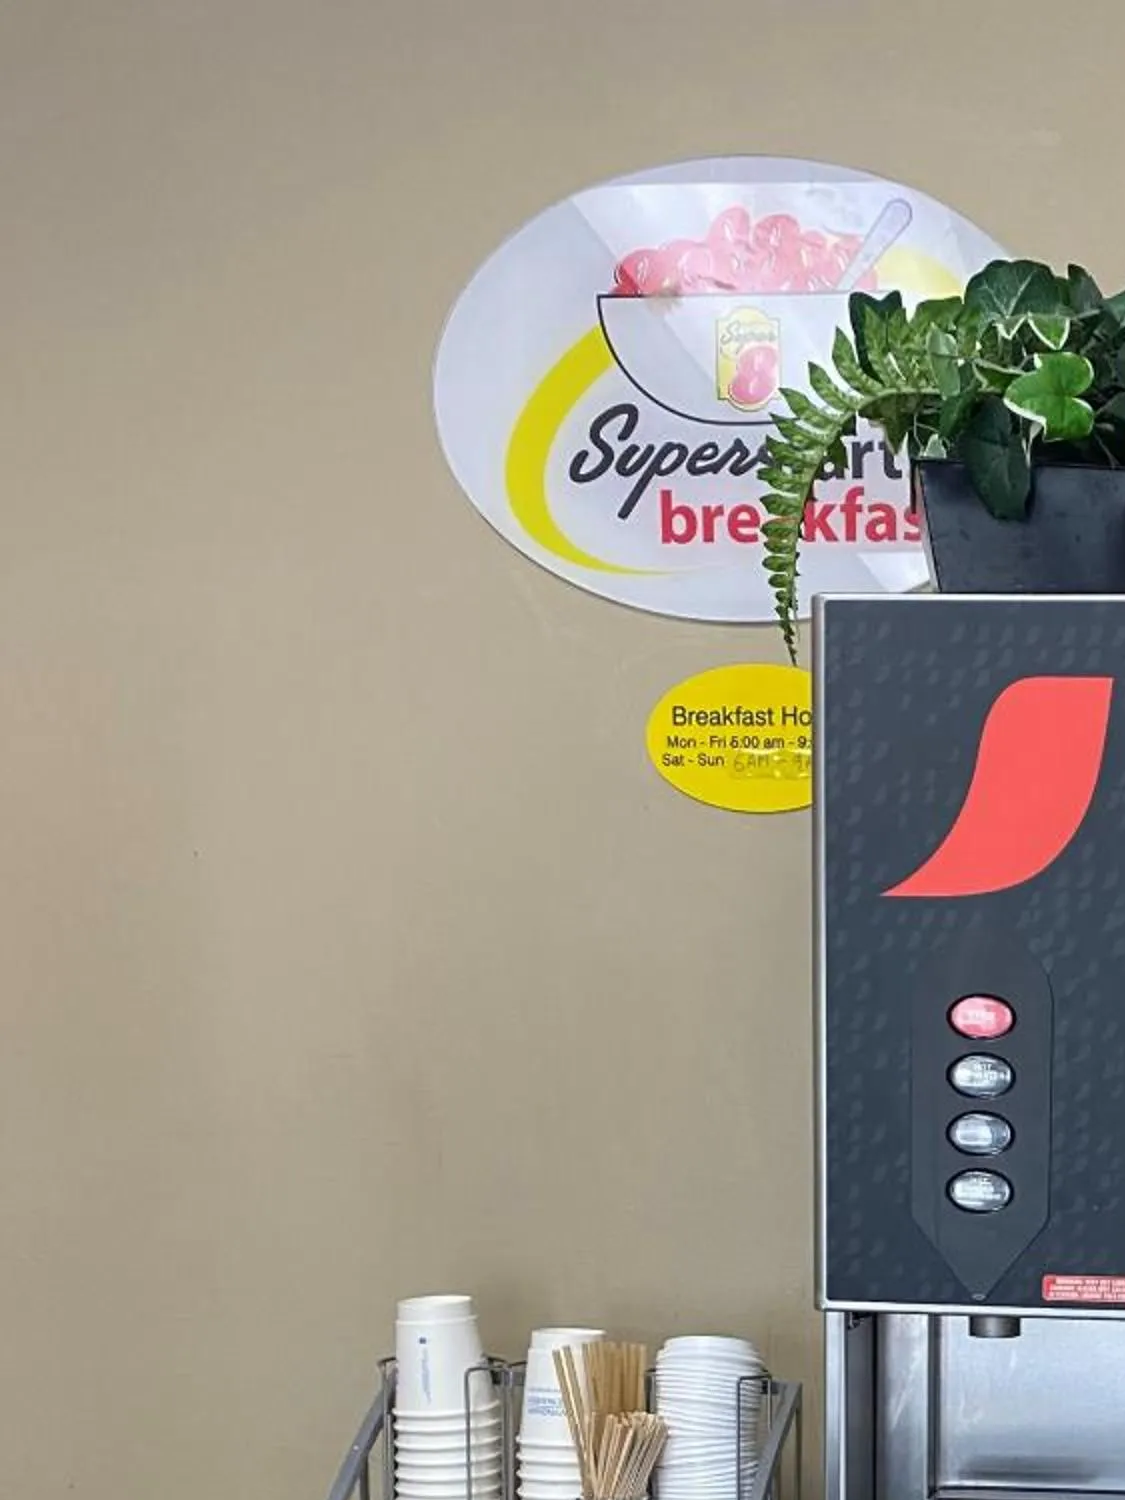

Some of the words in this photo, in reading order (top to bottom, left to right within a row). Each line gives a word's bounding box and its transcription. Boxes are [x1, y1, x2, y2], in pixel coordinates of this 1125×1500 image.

[660, 485, 922, 545] brekfas
[672, 705, 774, 727] Breakfast
[666, 735, 697, 748] Mon
[709, 735, 727, 748] Fri
[662, 753, 685, 767] Sat
[698, 753, 725, 767] Sun
